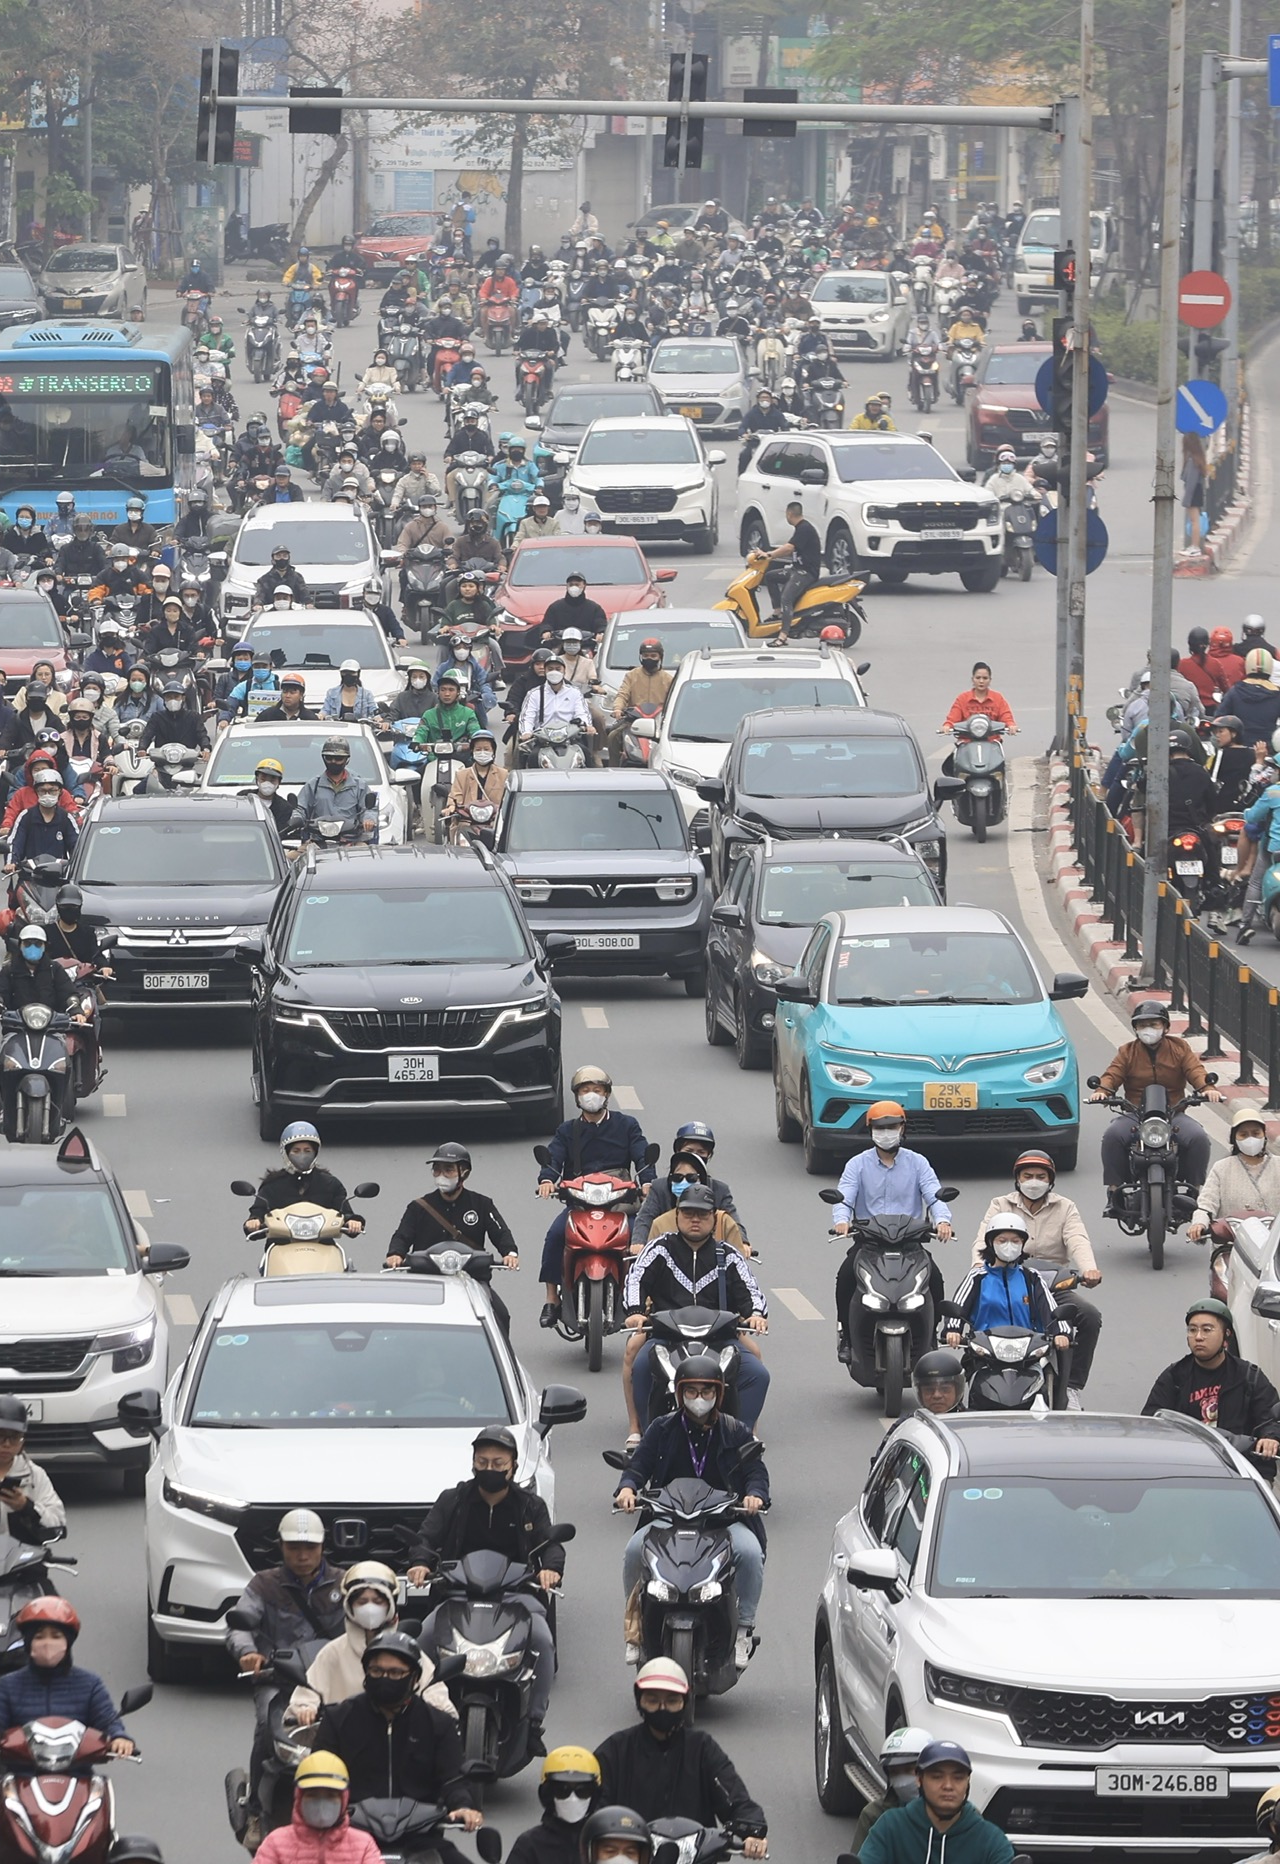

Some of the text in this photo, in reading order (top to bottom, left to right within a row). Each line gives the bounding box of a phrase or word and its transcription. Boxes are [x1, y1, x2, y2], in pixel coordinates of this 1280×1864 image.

[36, 375, 152, 392] TRANSERCO
[575, 937, 634, 948] 30L-908.00
[144, 975, 208, 988] 30F-761.78
[402, 1057, 425, 1069] 30H
[394, 1069, 434, 1081] 465.28
[939, 1084, 961, 1096] 29K
[929, 1097, 971, 1109] 066.35
[1134, 1711, 1185, 1725] KIA
[1107, 1774, 1218, 1792] 30M-246.88
